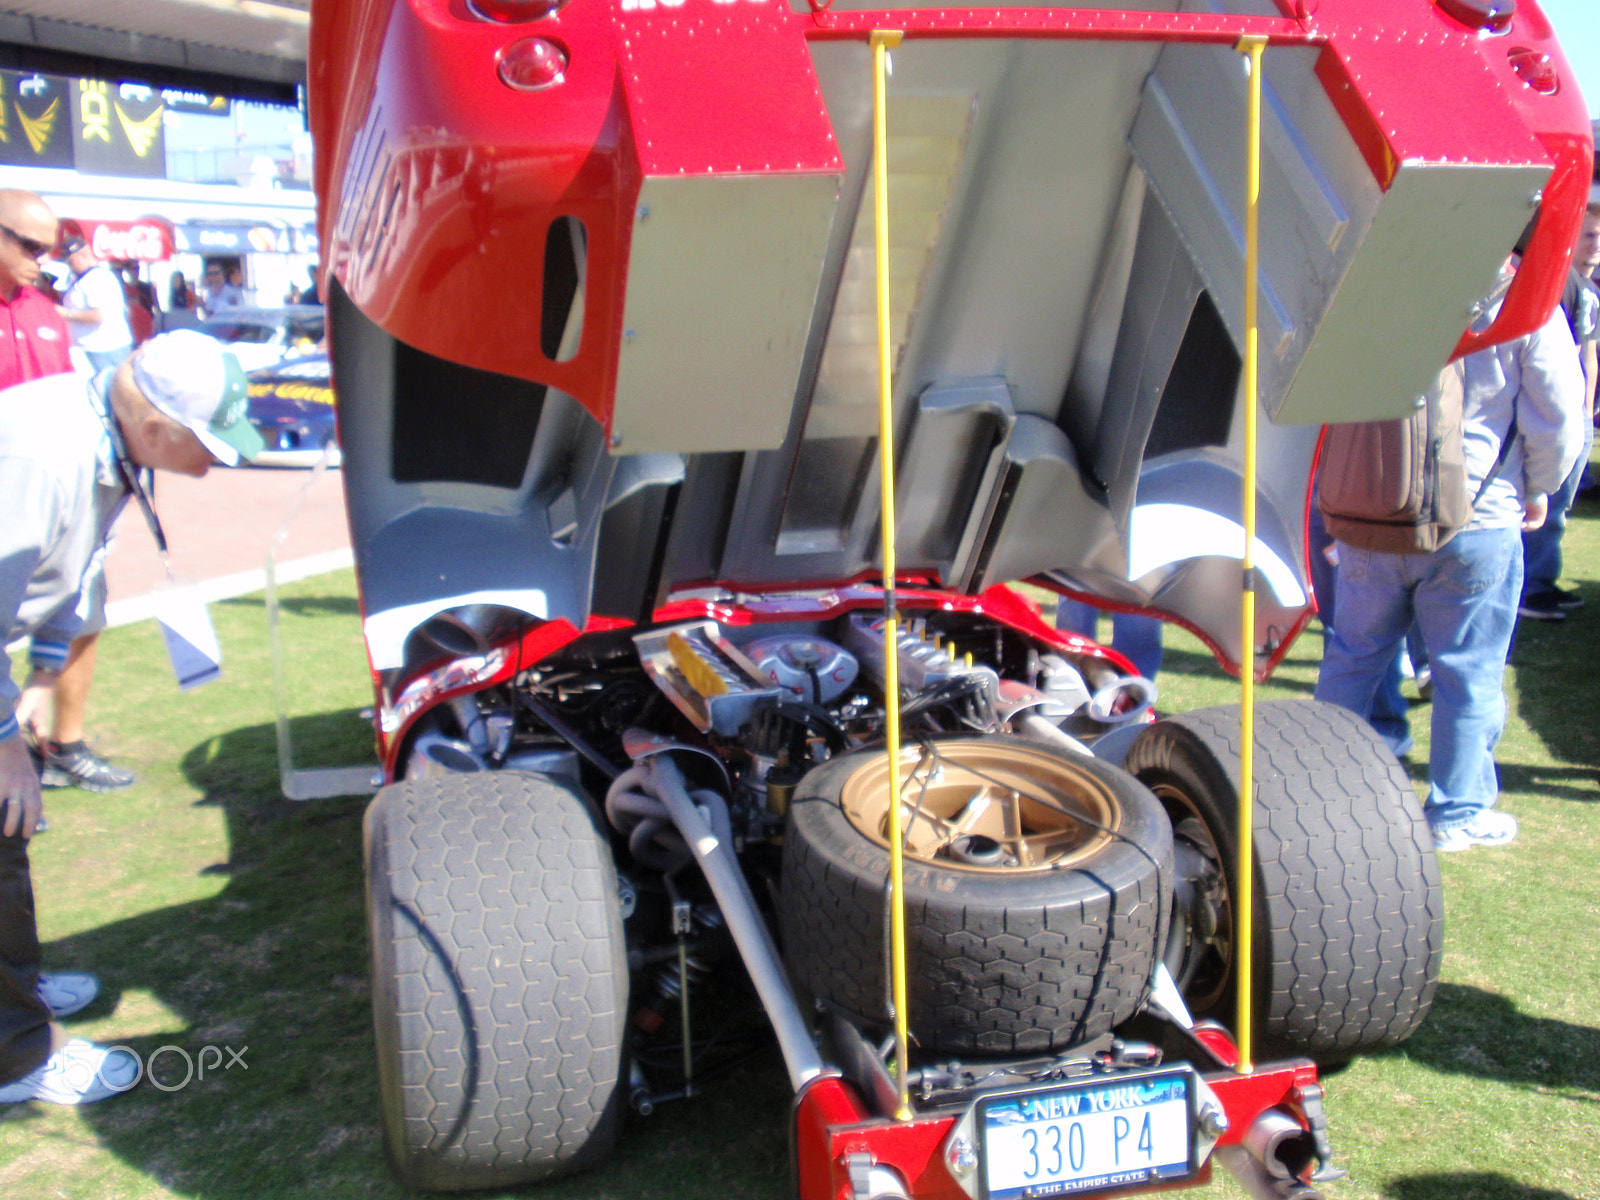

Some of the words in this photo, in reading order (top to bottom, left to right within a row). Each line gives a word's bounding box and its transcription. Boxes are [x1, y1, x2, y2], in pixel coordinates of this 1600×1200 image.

[1034, 1095, 1081, 1120] NEW
[1089, 1087, 1144, 1112] YORK
[1022, 1122, 1085, 1179] 330
[1113, 1110, 1154, 1167] P4
[1036, 1183, 1062, 1195] THE
[1064, 1177, 1109, 1191] EMPIRE
[1111, 1171, 1146, 1183] STATE
